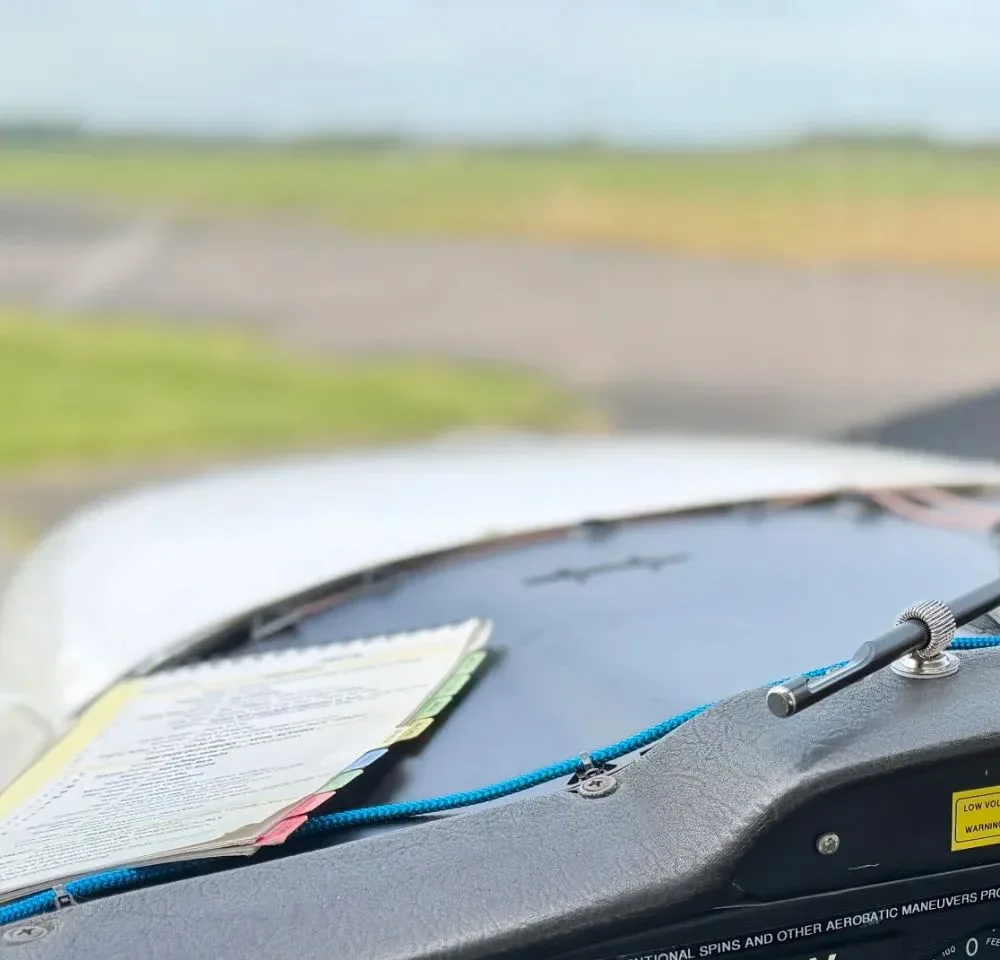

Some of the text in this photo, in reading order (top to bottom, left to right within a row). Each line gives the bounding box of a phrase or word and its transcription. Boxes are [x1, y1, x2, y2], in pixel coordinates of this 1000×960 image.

[964, 801, 982, 813] LOW
[699, 939, 741, 958] SPINS
[744, 932, 774, 948] AND
[776, 922, 822, 943] OTHER
[826, 907, 898, 932] AEROBATIC
[902, 892, 978, 916] MANEUVERS
[942, 946, 956, 957] 100
[966, 938, 979, 957] 0
